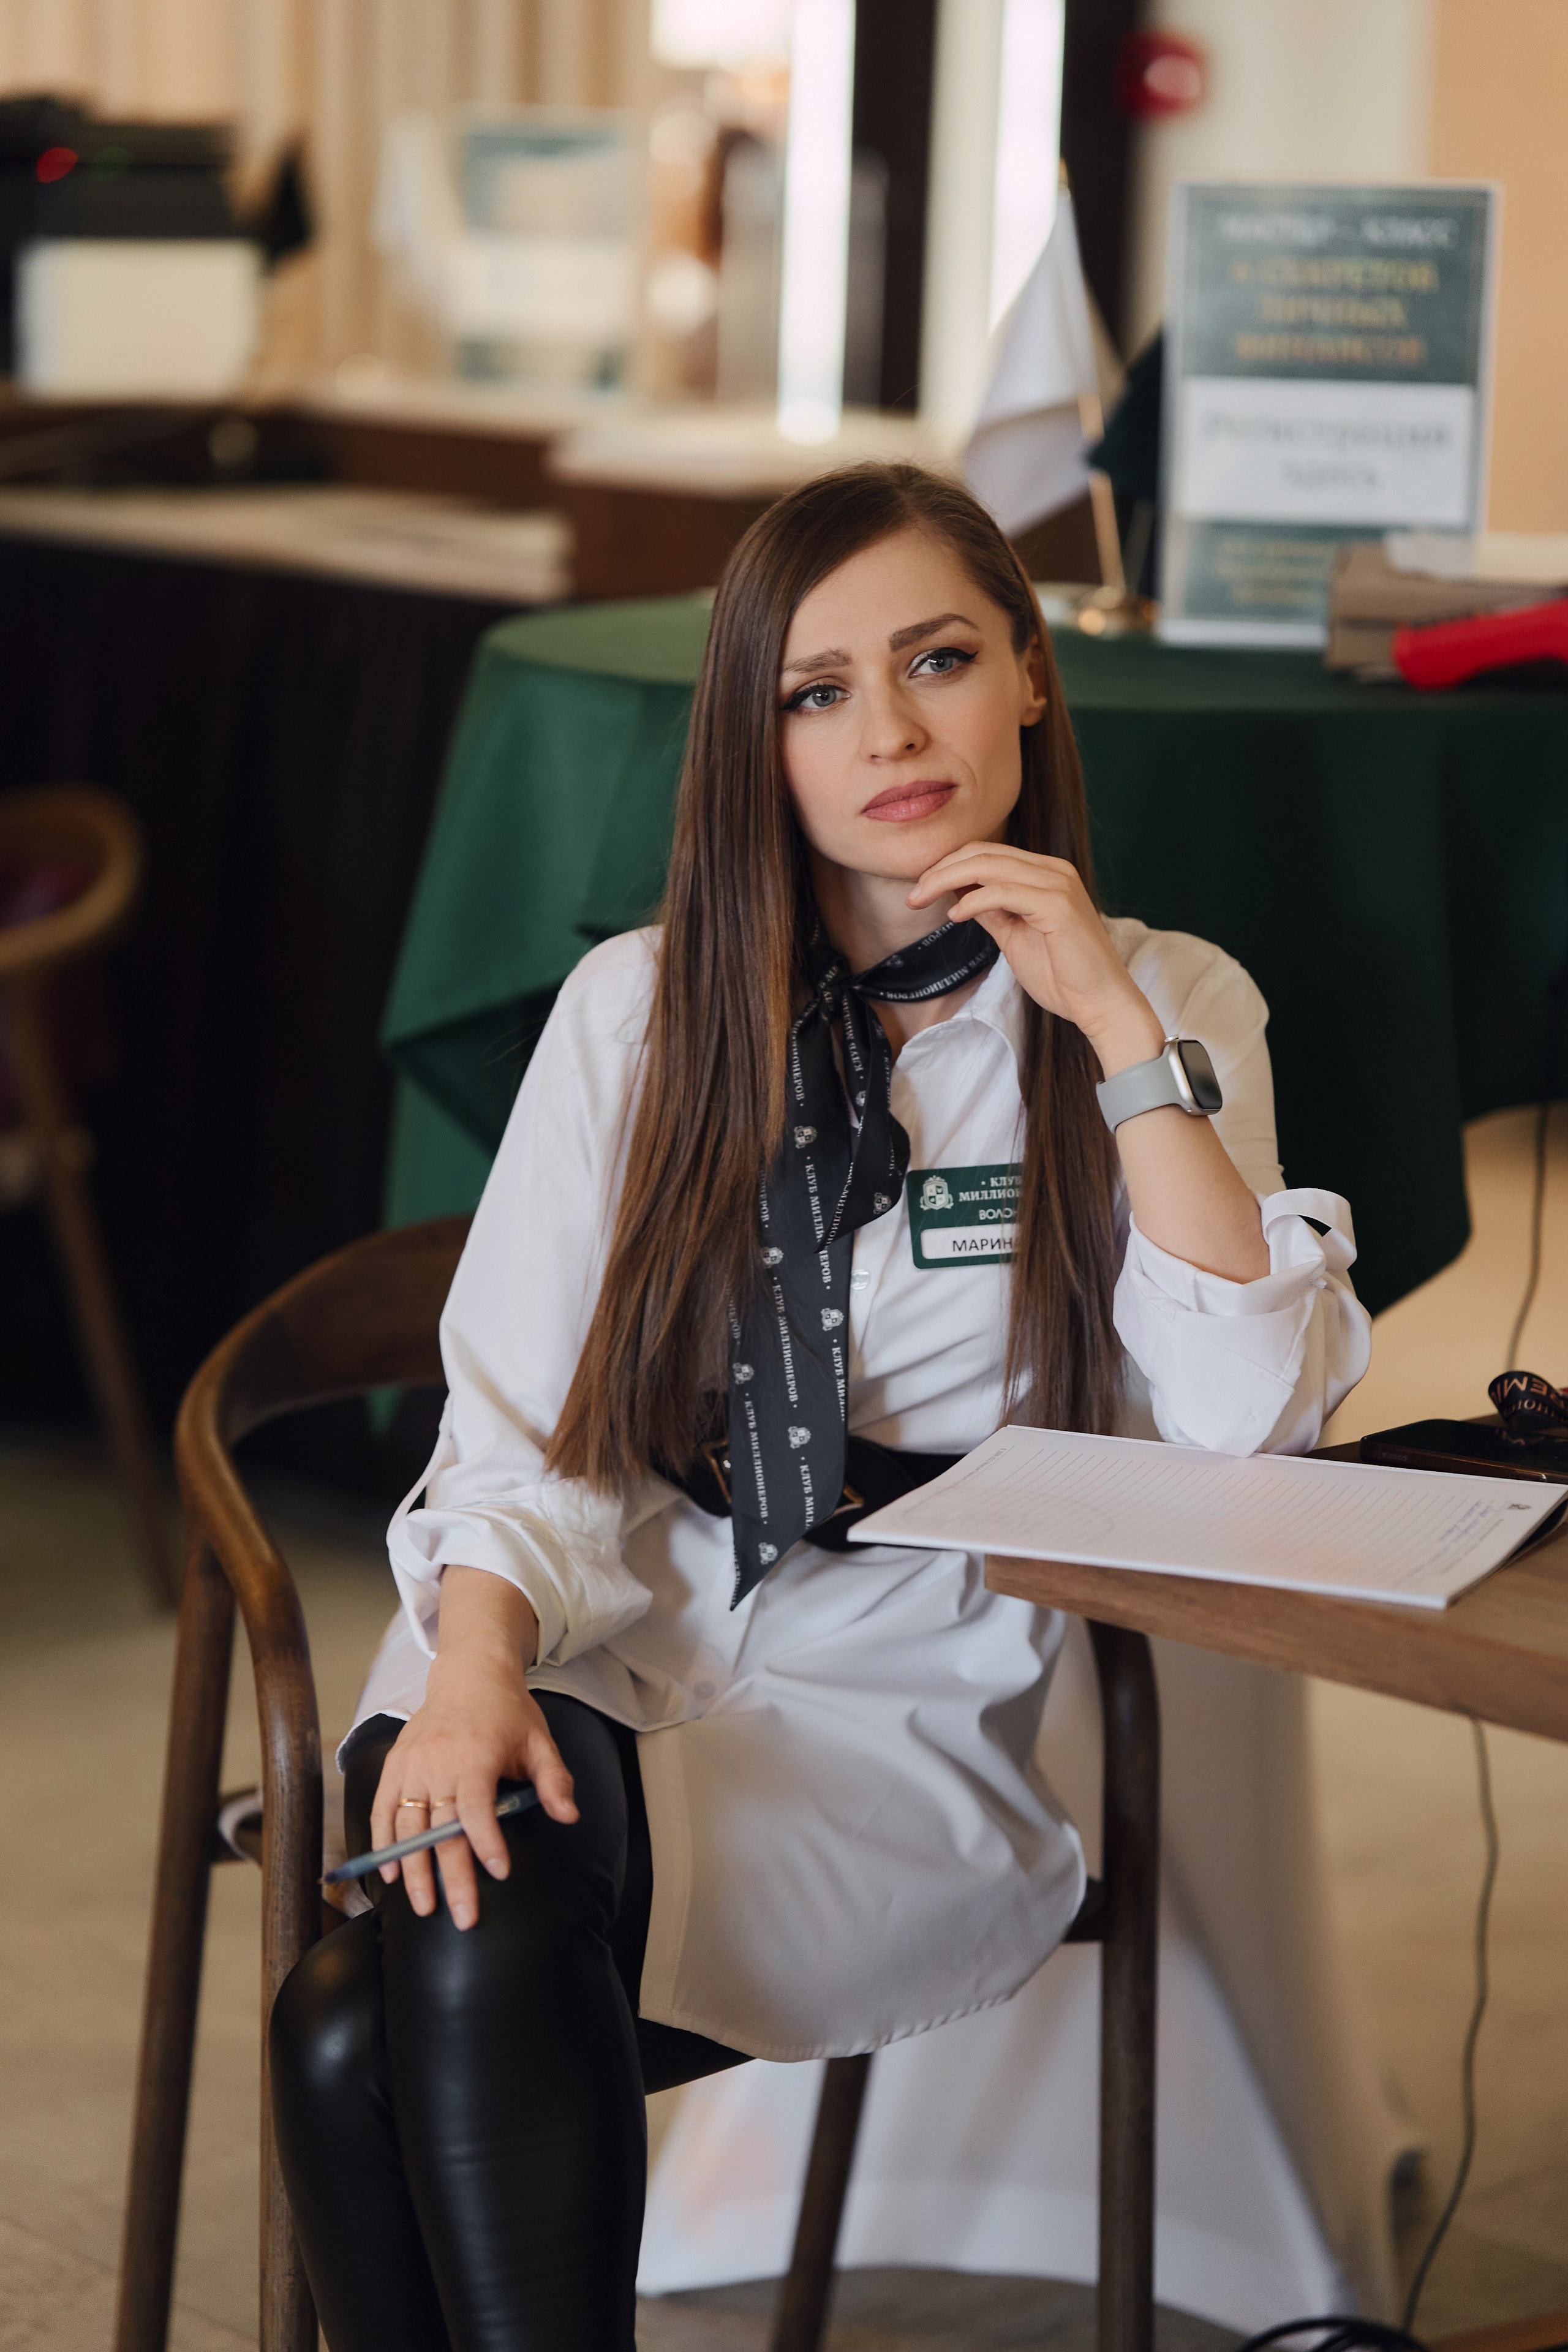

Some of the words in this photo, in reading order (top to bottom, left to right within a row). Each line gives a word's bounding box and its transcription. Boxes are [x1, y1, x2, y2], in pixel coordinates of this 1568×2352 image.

[841, 997, 854, 1040] МИЛЛИ
[805, 1164, 818, 1194] КЛУБ
[772, 1284, 786, 1313] КЛУБ
[777, 1316, 799, 1403] МИЛЛИОНЕРОВ
[832, 1346, 844, 1376] КЛУБ
[744, 1400, 757, 1430] КЛУБ
[749, 1431, 769, 1518] МИЛЛИОНЕРОВ
[799, 1464, 813, 1494] КЛУБ
